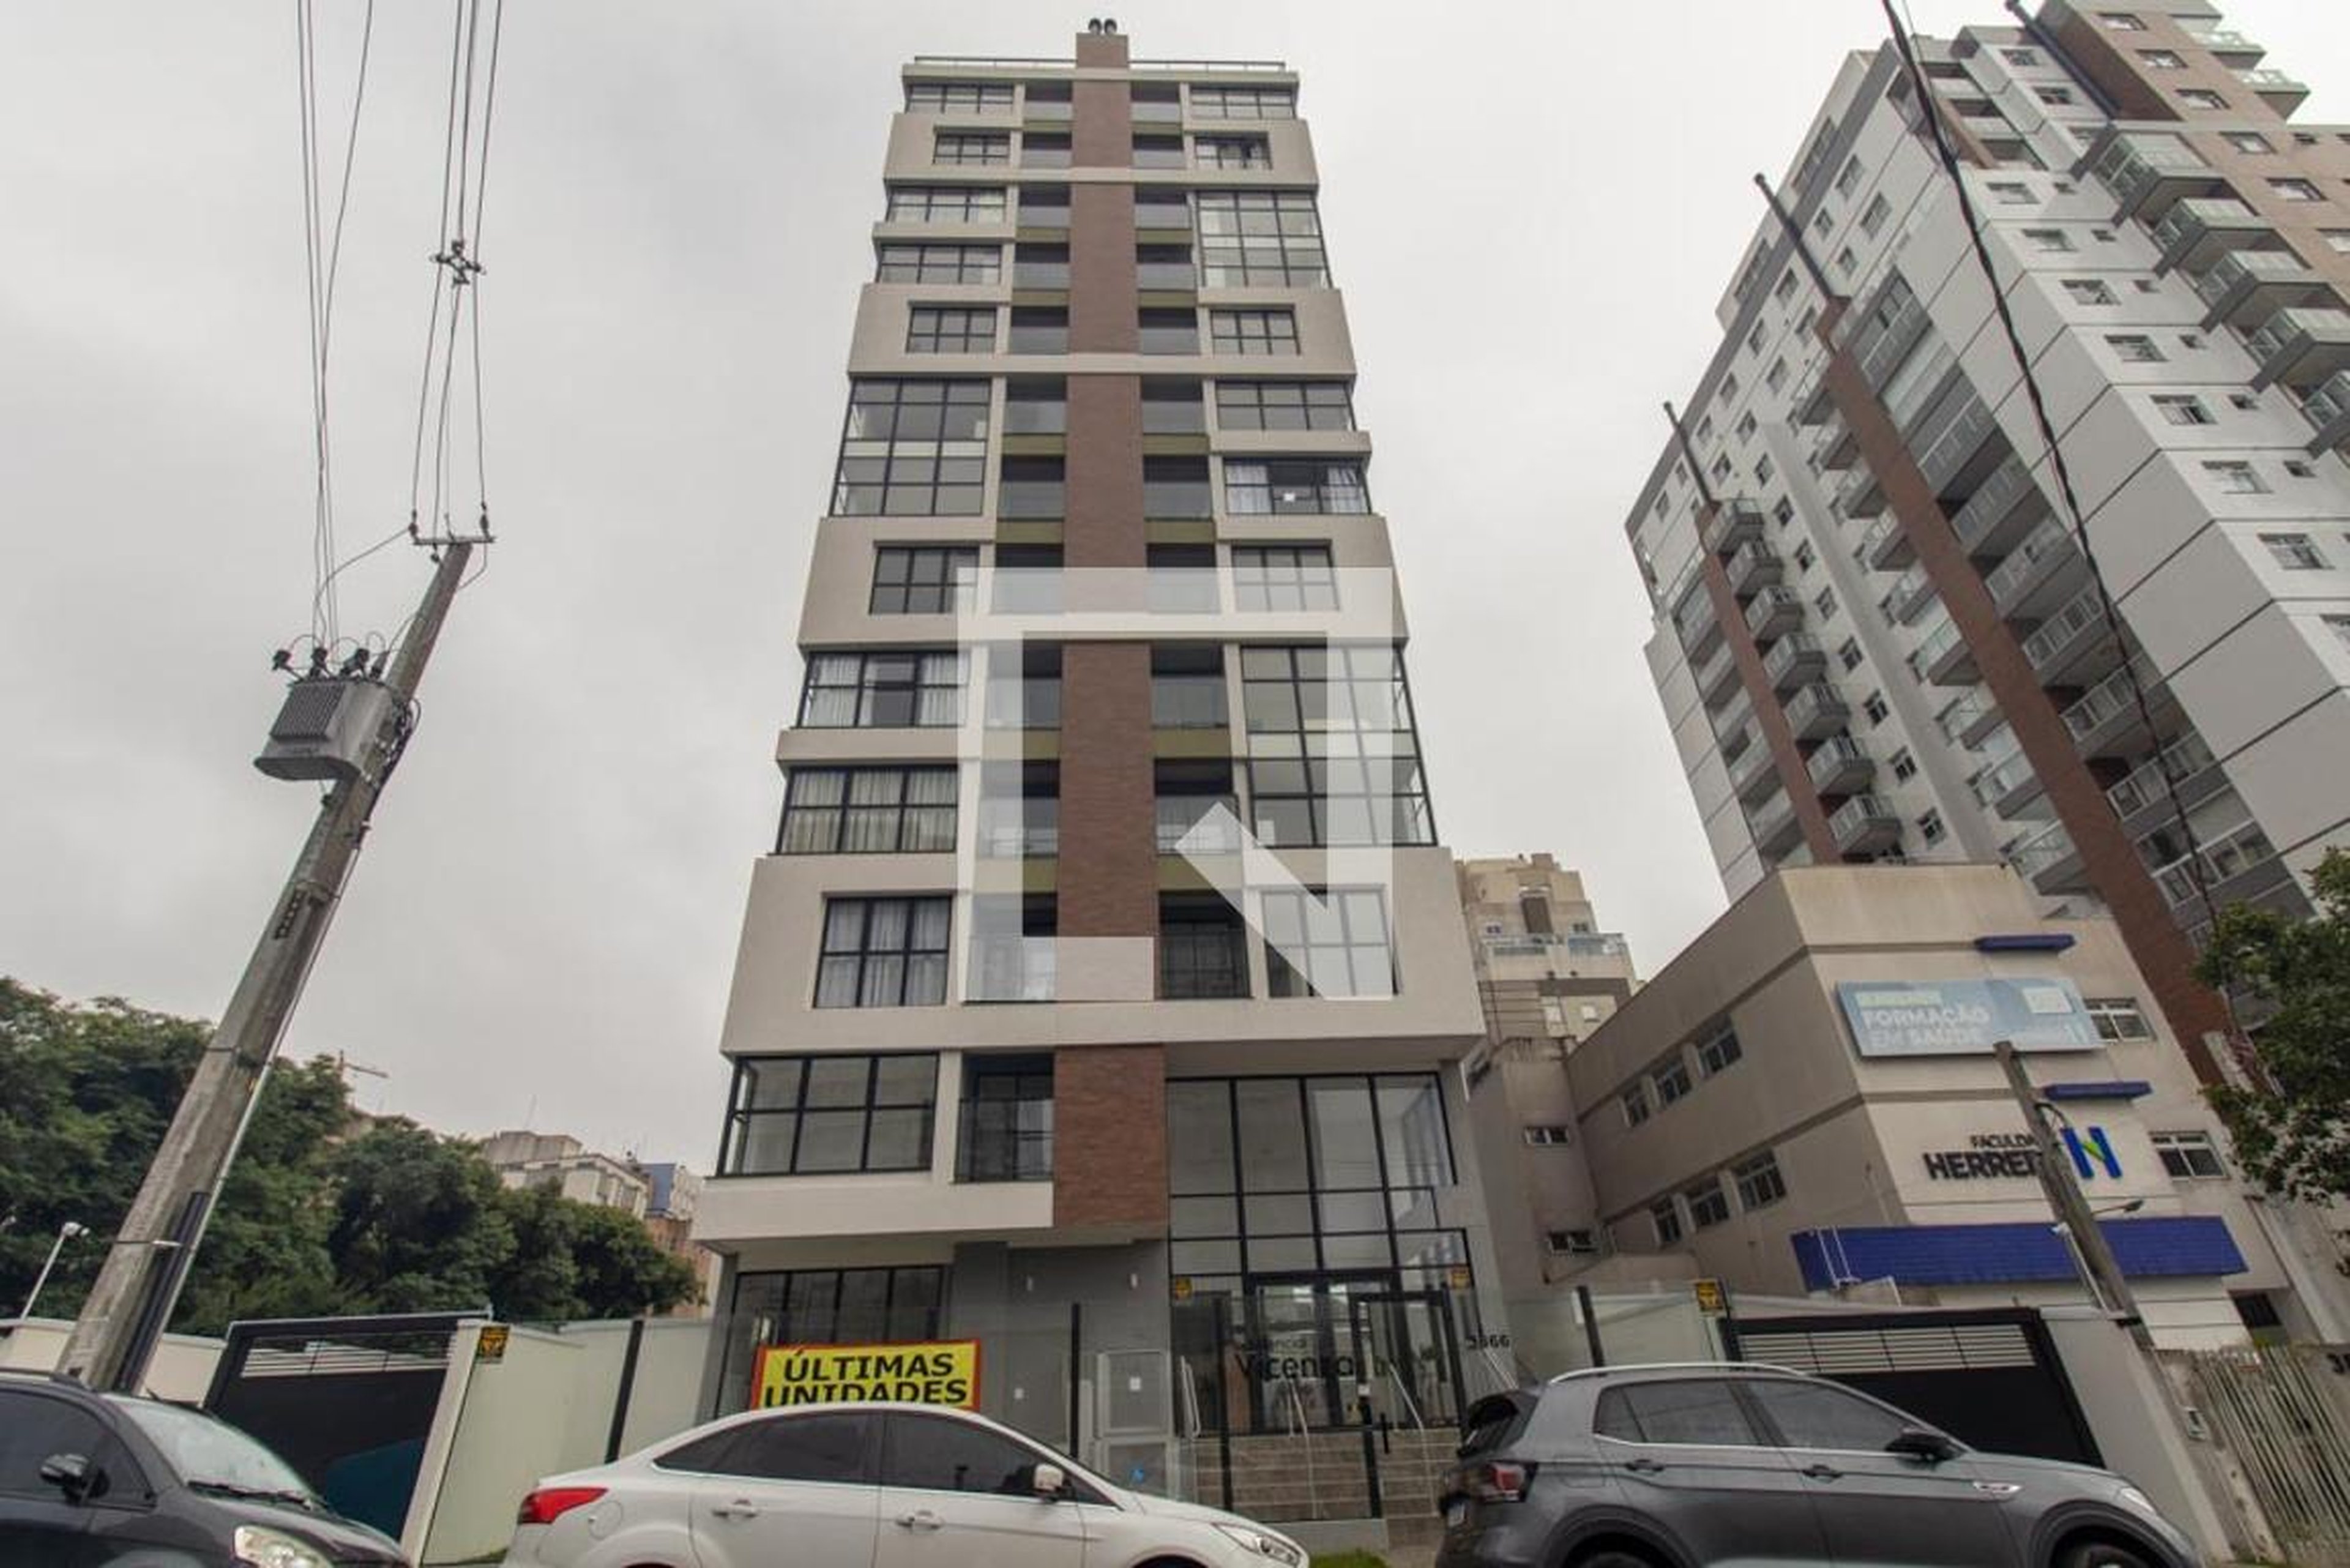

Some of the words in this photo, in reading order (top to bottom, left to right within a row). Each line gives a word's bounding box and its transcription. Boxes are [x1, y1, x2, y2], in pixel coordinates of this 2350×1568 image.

[1862, 1005, 1990, 1029] FORMAÇÃO
[1970, 1133, 2037, 1149] FACULDA
[1922, 1151, 2042, 1179] HERRE
[784, 1349, 953, 1381] ÚLTIMAS
[766, 1379, 967, 1407] UNIDADES
